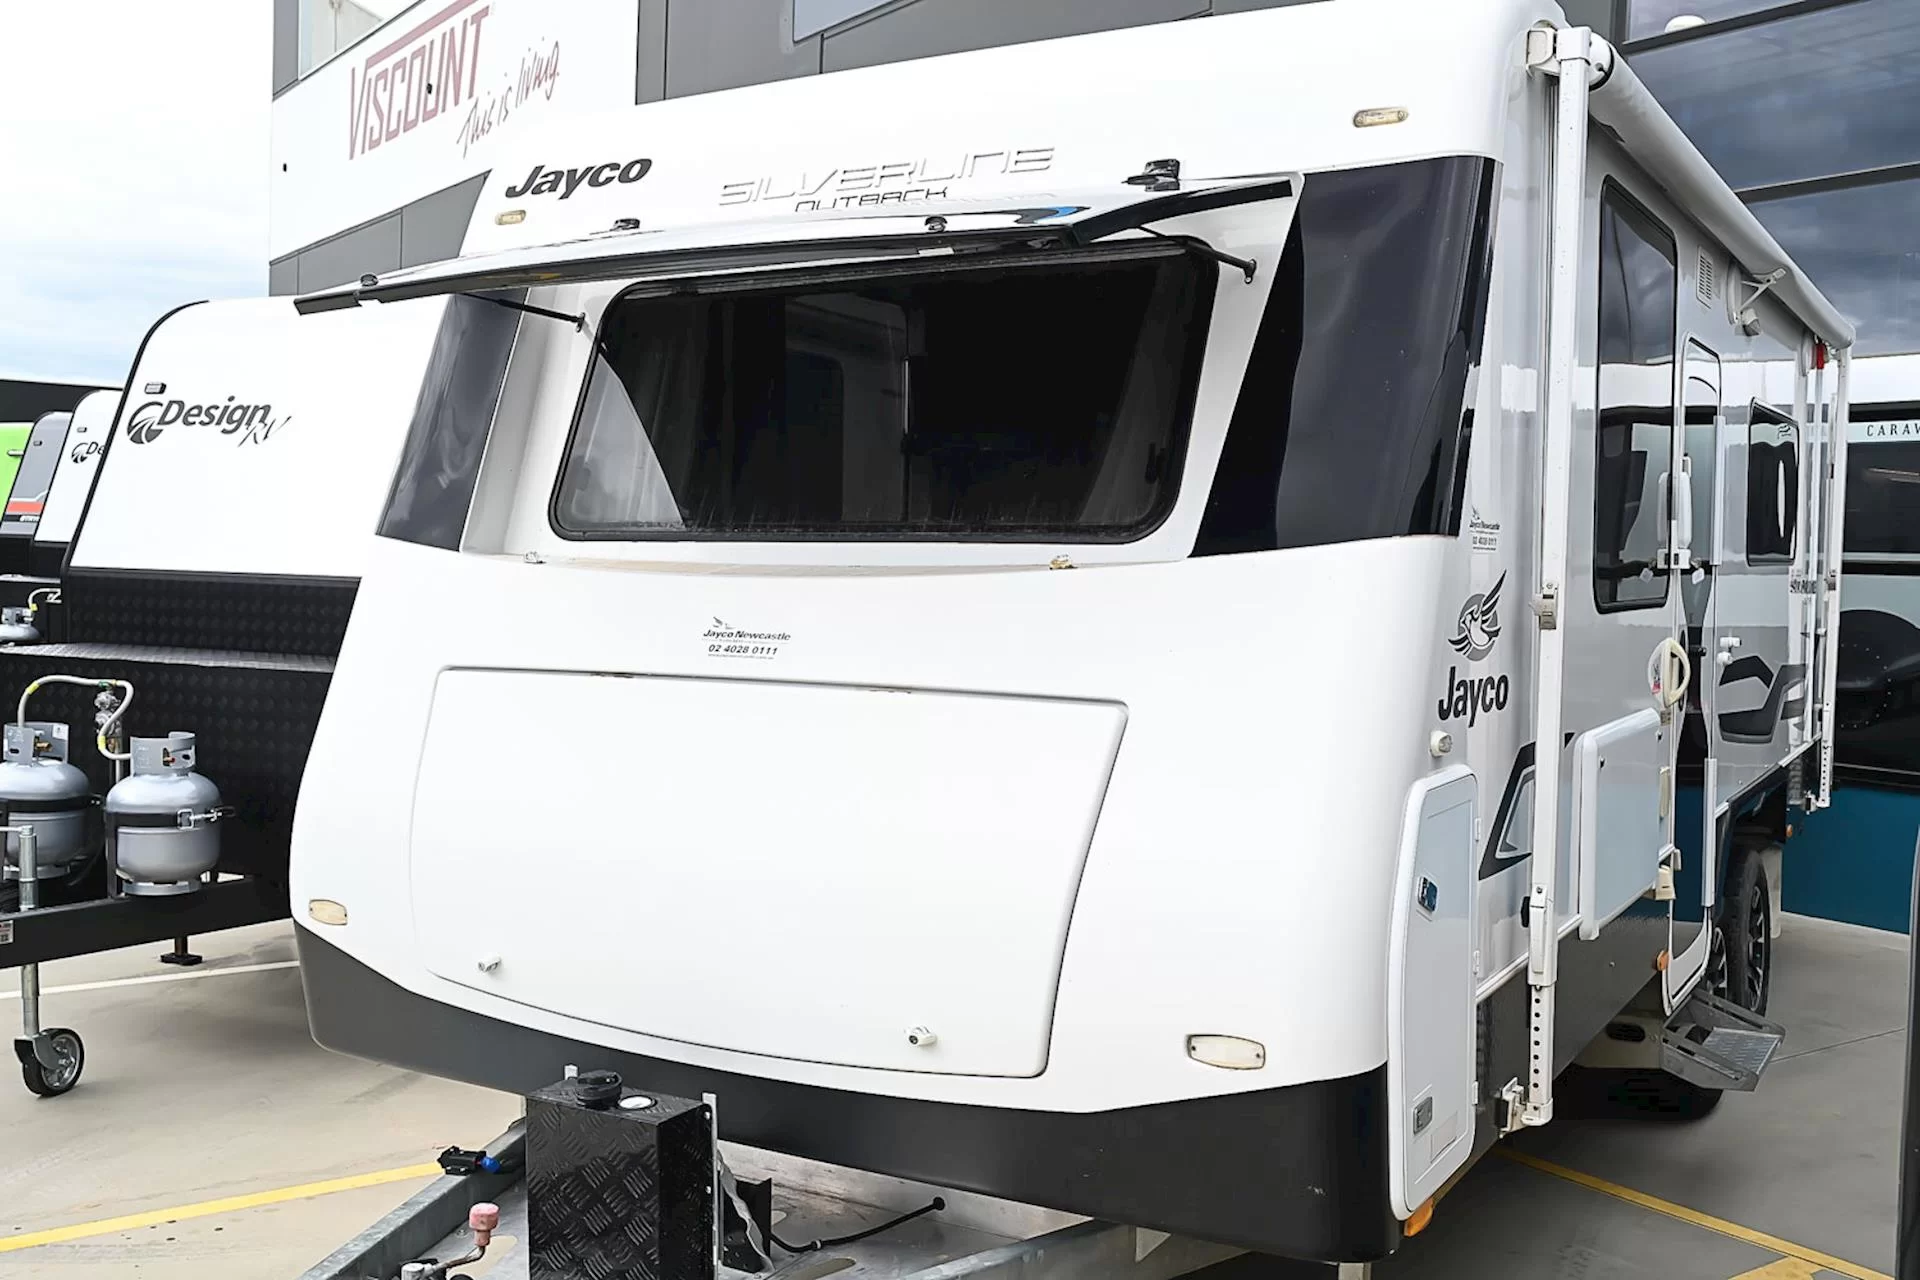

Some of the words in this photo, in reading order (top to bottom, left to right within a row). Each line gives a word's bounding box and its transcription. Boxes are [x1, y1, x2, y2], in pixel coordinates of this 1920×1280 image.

[350, 5, 490, 160] VISCOUNT
[456, 91, 496, 160] This
[497, 72, 513, 127] is
[505, 158, 652, 200] Jayco
[719, 147, 1055, 206] SILVERLINE
[157, 395, 271, 435] Design
[703, 629, 734, 639] Jayco
[735, 630, 791, 641] Newcastle
[708, 644, 721, 653] 02
[723, 644, 750, 654] 4028
[752, 646, 778, 655] 0111
[1438, 665, 1509, 728] Jayco
